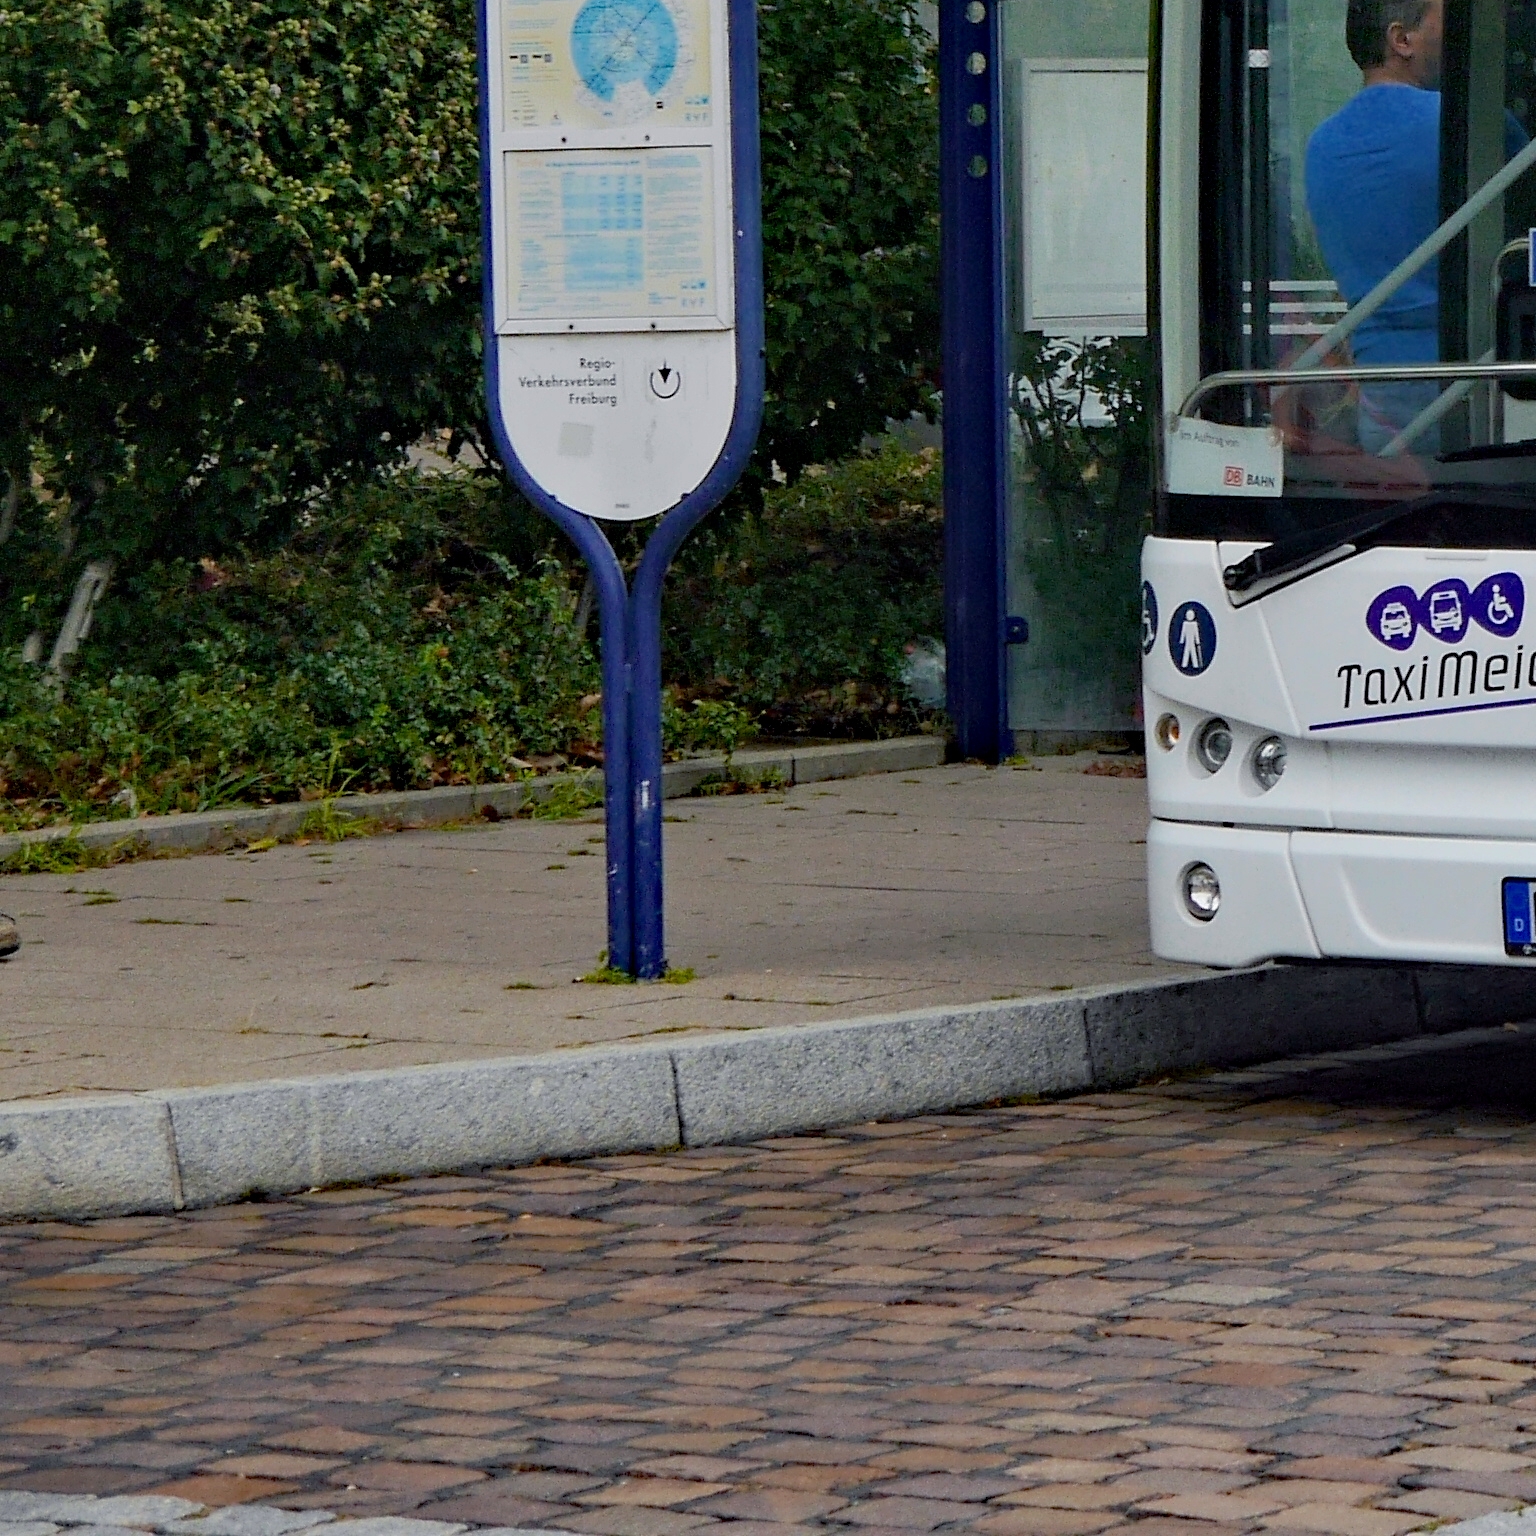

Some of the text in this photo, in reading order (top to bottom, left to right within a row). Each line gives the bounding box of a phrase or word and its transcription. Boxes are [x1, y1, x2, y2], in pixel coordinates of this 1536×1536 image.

[579, 357, 616, 372] Regio-
[518, 371, 617, 388] Verkehrsverbund
[568, 392, 618, 407] Freiburg
[1225, 468, 1276, 488] DB BAHN
